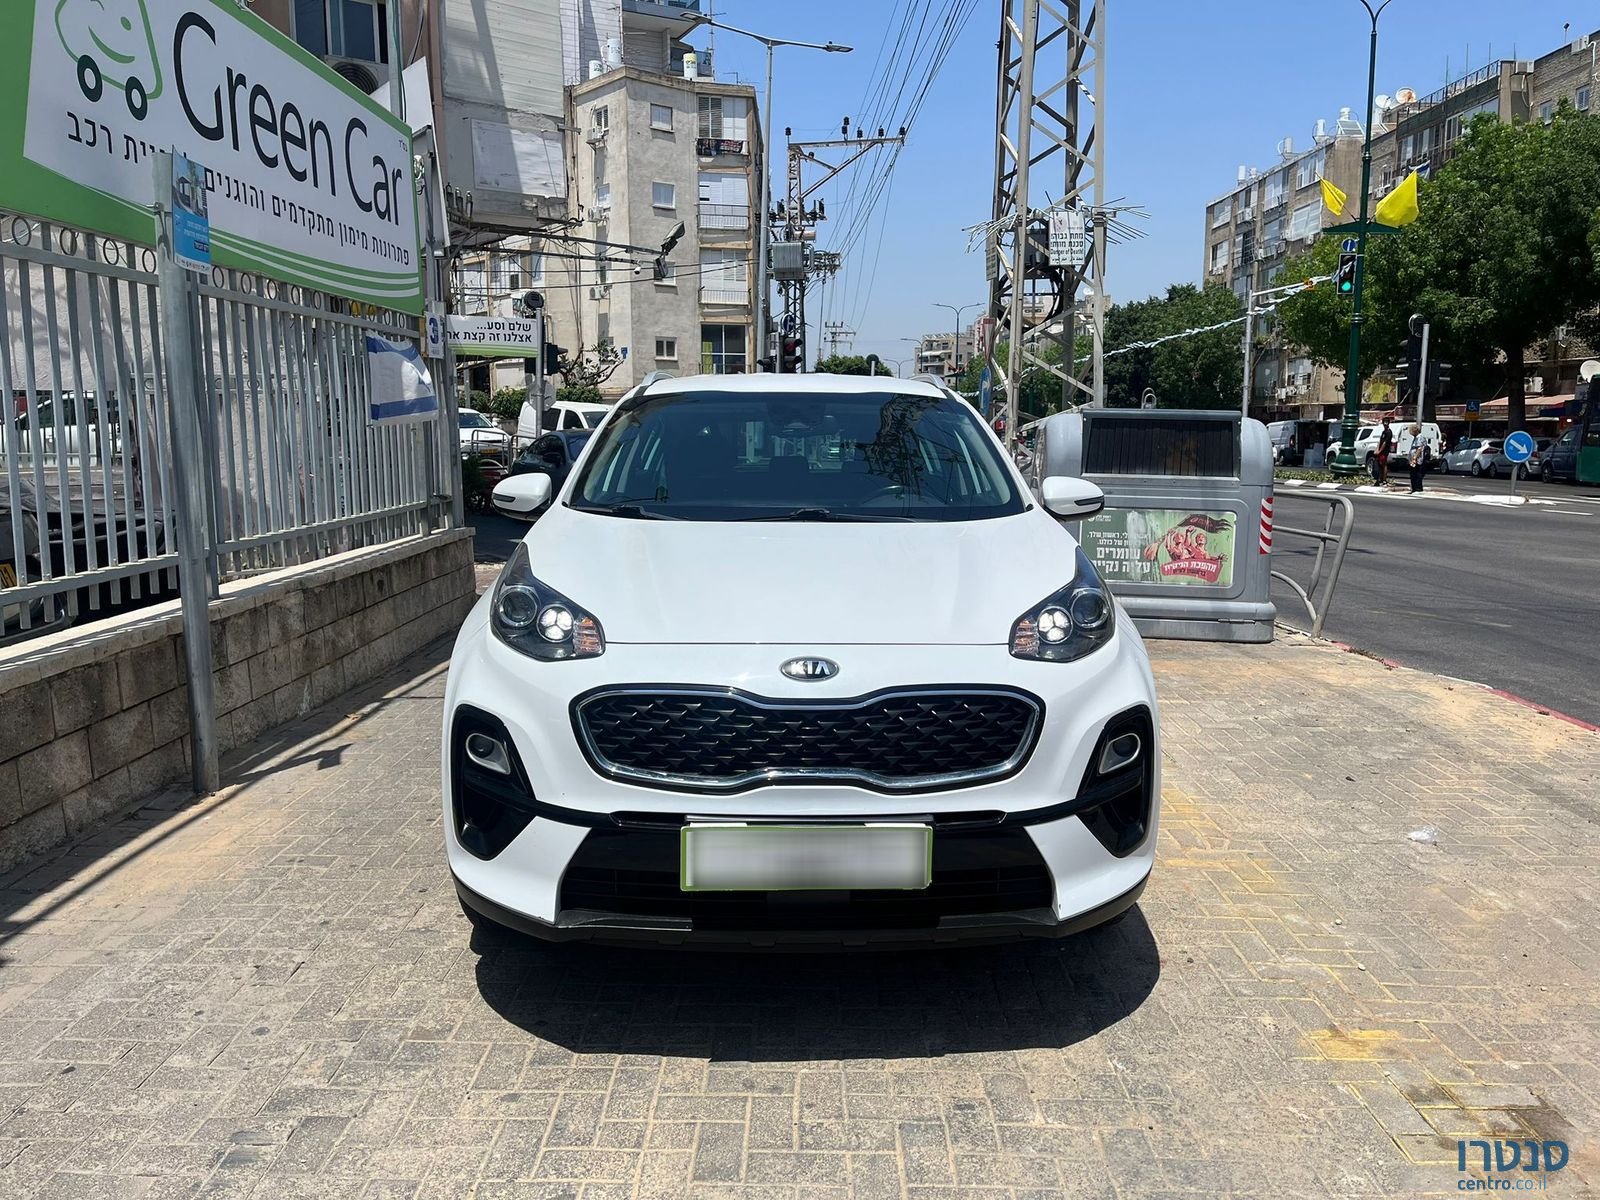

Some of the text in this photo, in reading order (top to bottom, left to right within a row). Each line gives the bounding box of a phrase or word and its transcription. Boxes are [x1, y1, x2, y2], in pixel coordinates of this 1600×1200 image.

[173, 11, 402, 226] Green Car
[67, 111, 112, 154] רכב
[204, 168, 265, 211] והוגנים
[272, 195, 334, 238] מתקדמים
[339, 222, 368, 249] מימון
[371, 236, 409, 266] פתרונות
[476, 321, 531, 331] שלם וסע...
[464, 332, 485, 342] קצת
[489, 332, 500, 342] זה
[504, 332, 532, 342] אצלנו
[1096, 548, 1140, 559] שומרים
[791, 660, 830, 675] KIA
